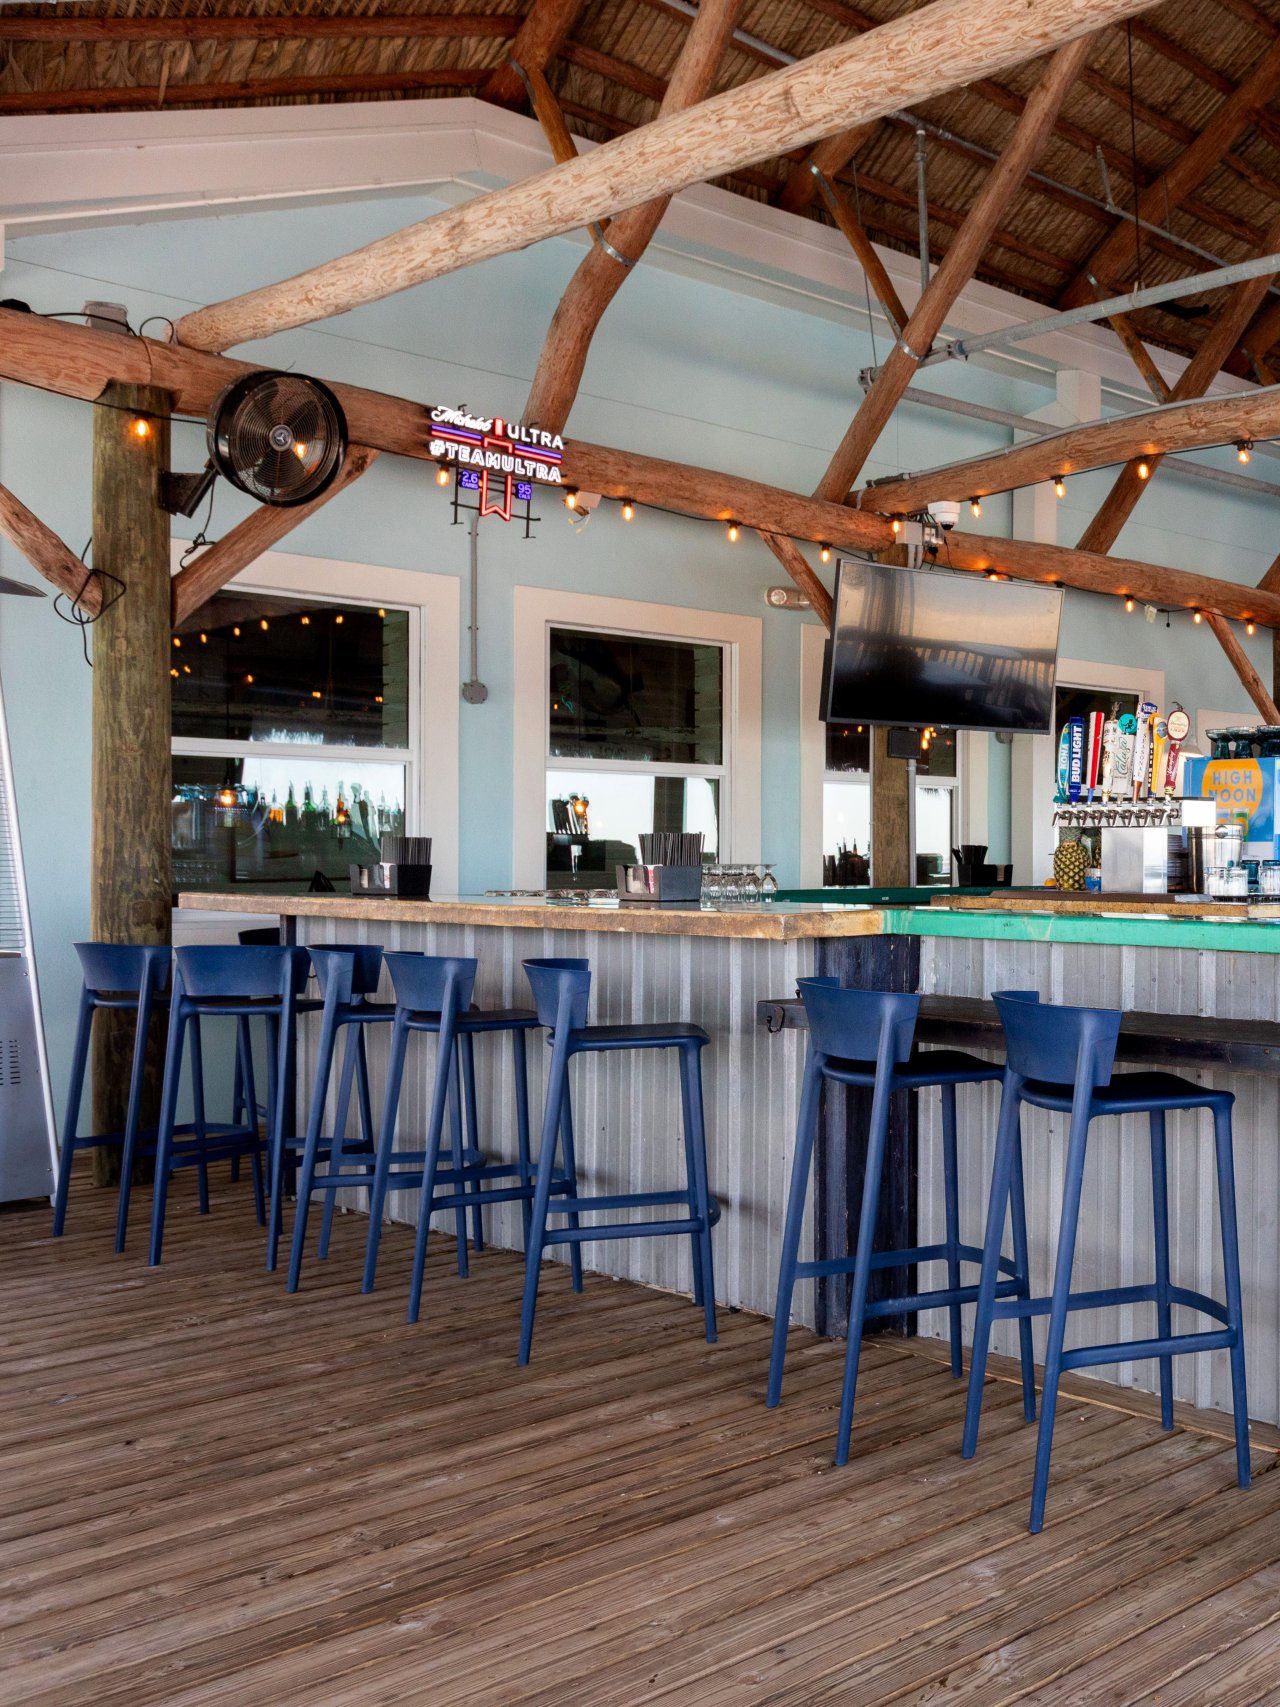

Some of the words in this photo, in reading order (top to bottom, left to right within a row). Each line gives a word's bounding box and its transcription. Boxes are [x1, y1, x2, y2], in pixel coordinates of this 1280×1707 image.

[431, 406, 493, 431] Michelob
[507, 424, 563, 450] ULTRA
[429, 439, 562, 483] #TEAMULTRA
[462, 471, 479, 484] 2.6
[517, 484, 532, 495] 95
[1073, 725, 1083, 759] LIGHT
[1060, 743, 1069, 769] KONA
[1115, 736, 1131, 775] Calusa
[1071, 760, 1082, 783] BUD
[1212, 770, 1253, 785] HIGH
[1208, 788, 1257, 802] NOON
